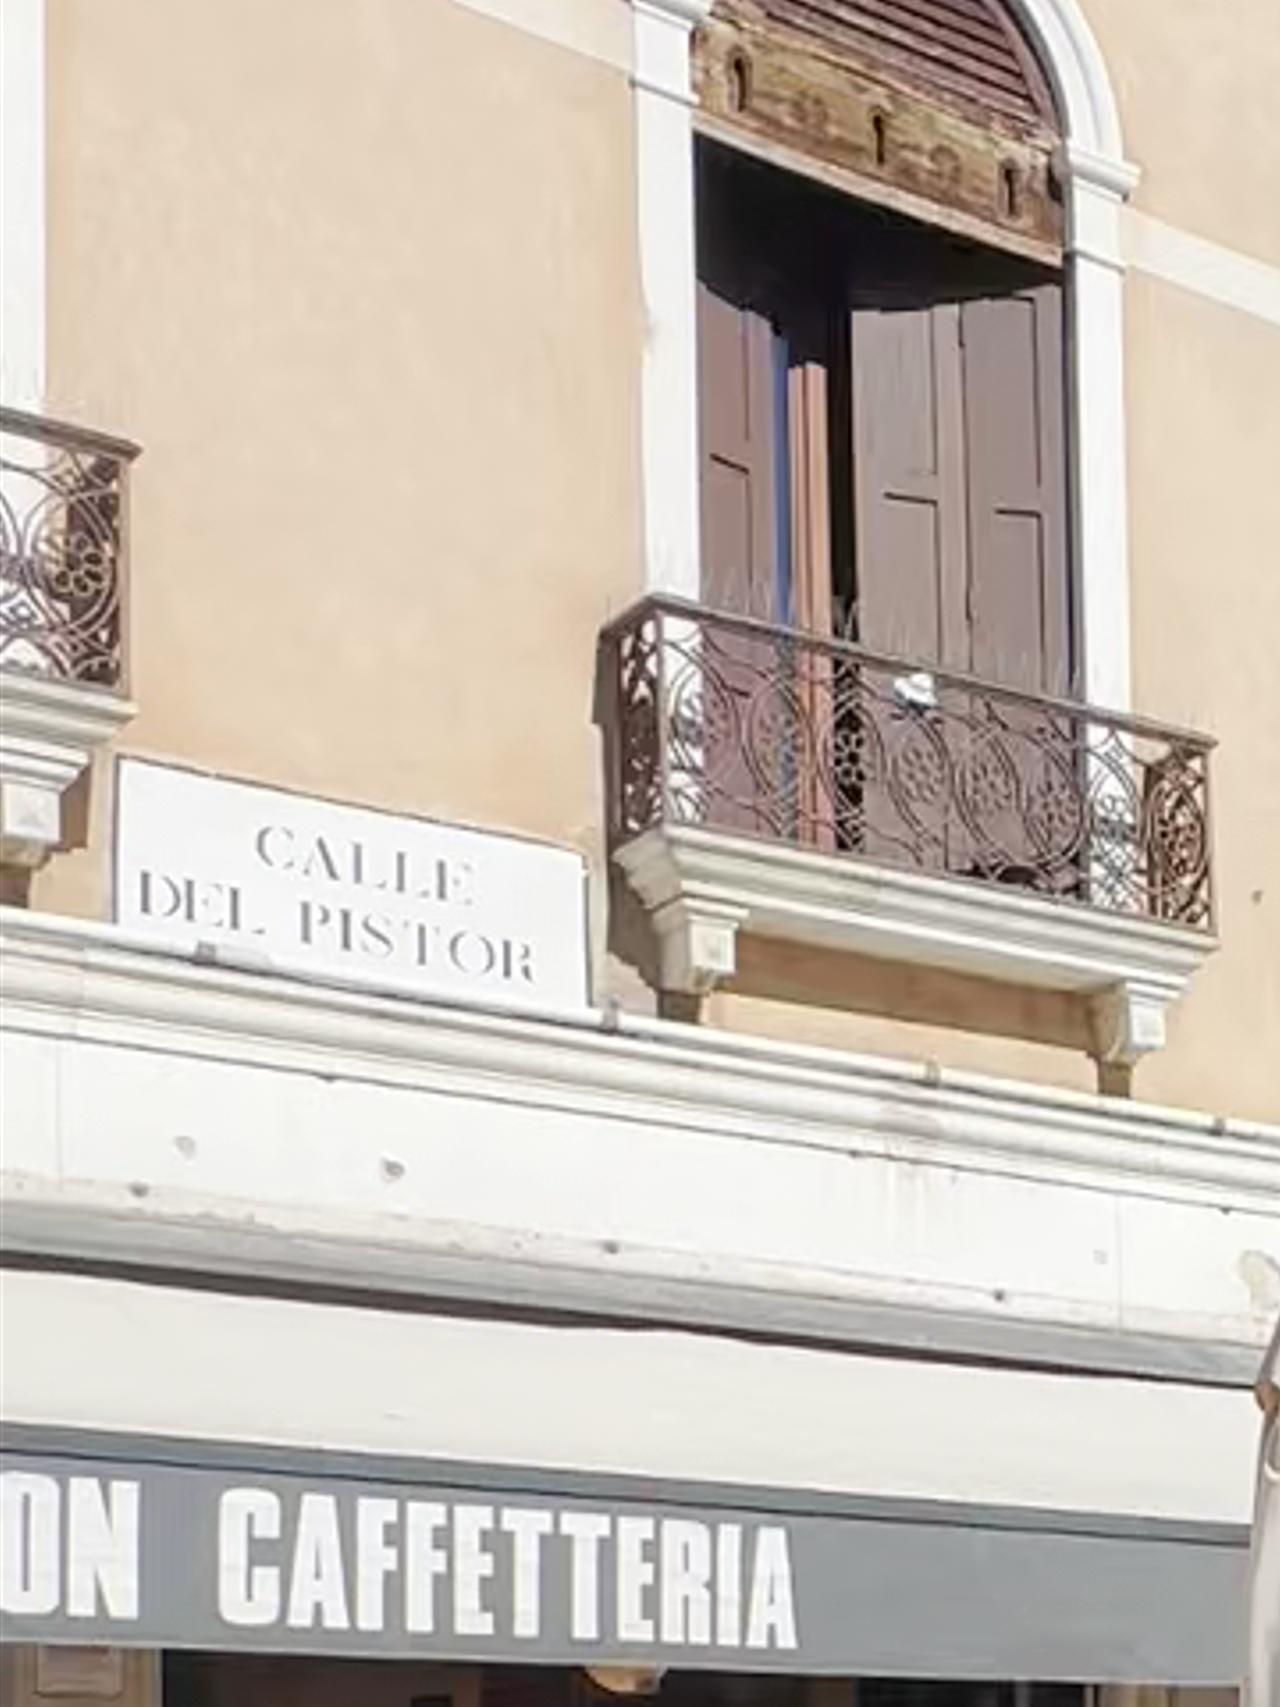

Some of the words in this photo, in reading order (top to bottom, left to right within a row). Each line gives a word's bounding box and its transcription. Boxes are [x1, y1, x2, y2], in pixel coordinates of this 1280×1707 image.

[256, 825, 474, 906] CALLE
[139, 869, 266, 936] DEL
[299, 900, 536, 983] PISTOR
[0, 1471, 141, 1620] ON
[218, 1487, 799, 1649] CAFFETTERIA
